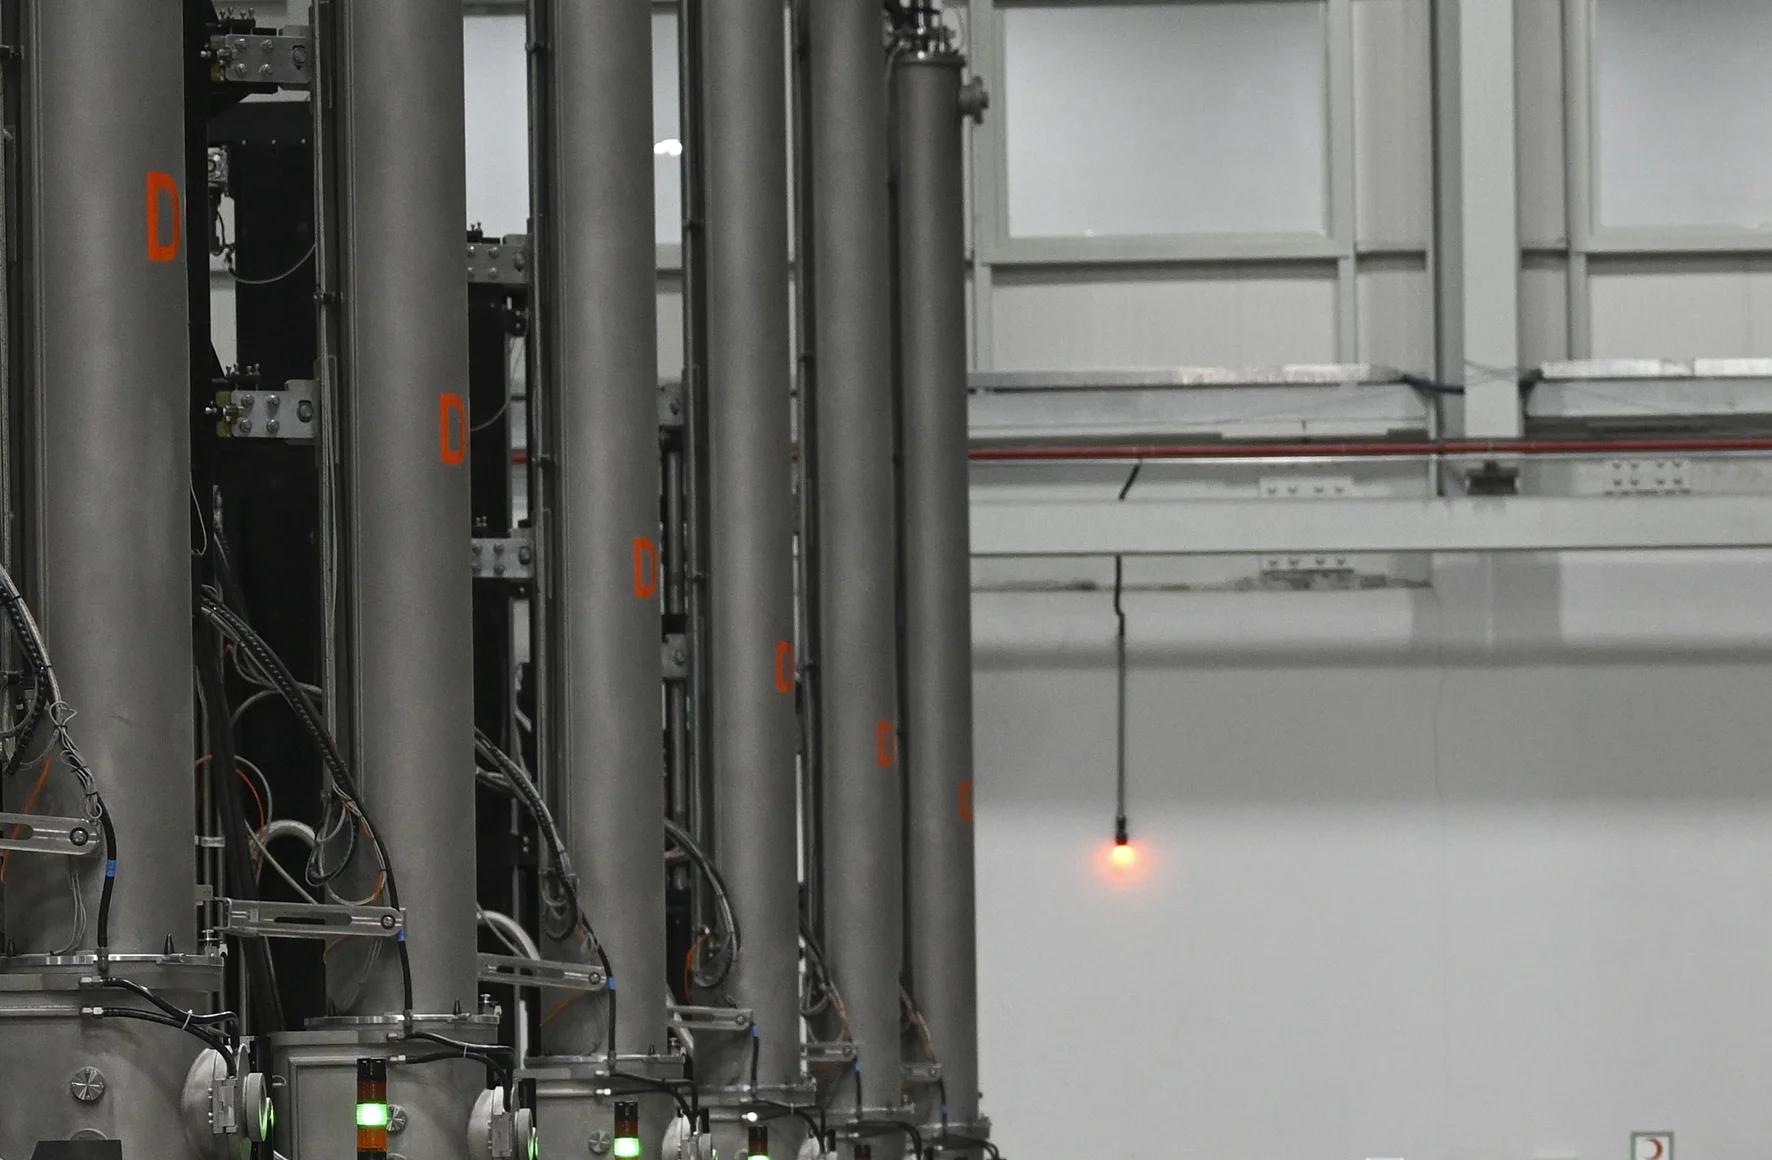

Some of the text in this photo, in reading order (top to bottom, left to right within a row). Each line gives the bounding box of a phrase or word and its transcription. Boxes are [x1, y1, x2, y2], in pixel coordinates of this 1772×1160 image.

[145, 170, 181, 263] D
[439, 392, 466, 465] D
[633, 536, 657, 599] D
